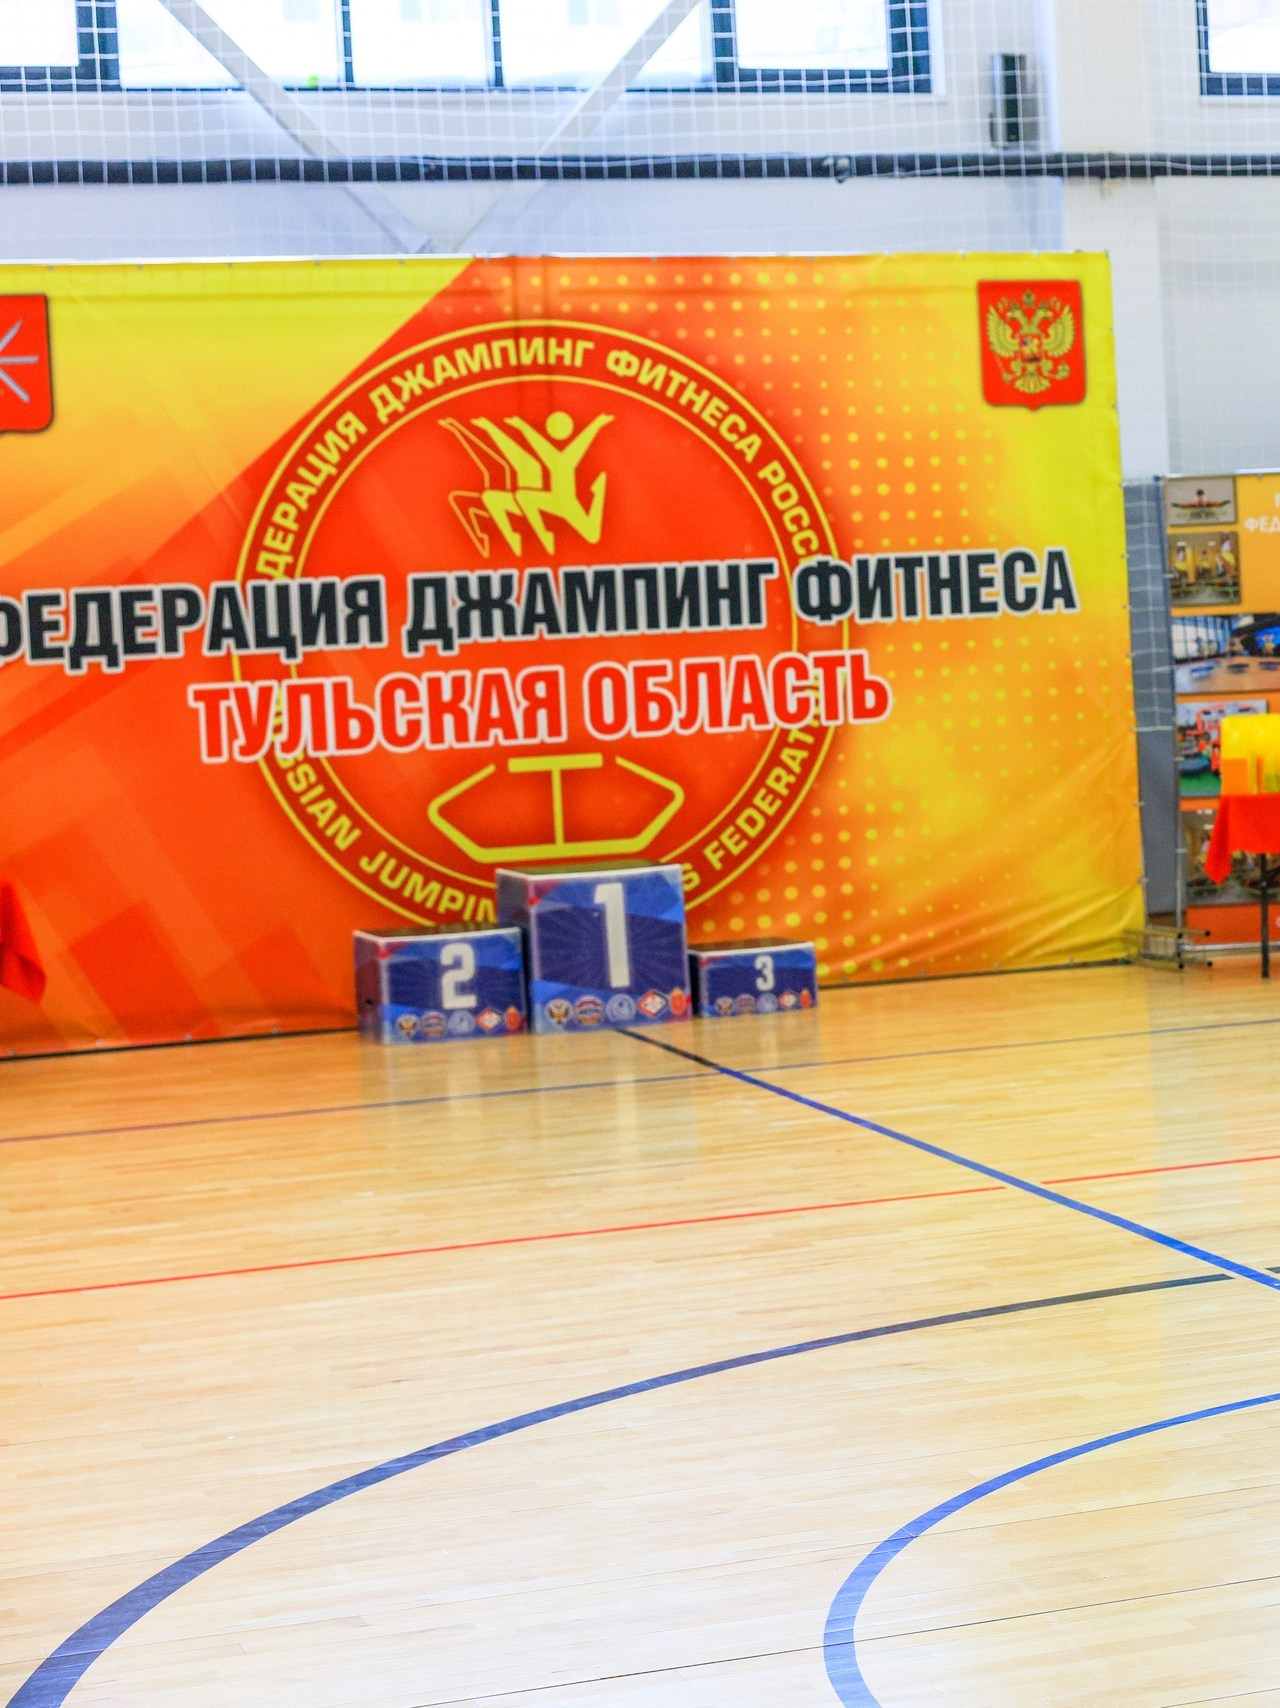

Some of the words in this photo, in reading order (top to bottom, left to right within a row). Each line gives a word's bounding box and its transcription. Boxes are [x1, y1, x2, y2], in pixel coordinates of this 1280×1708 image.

[256, 411, 367, 580] ДЕРАЦИЯ
[369, 337, 595, 424] ДЖАМПИНГ
[606, 350, 763, 464] ФИТНЕСА
[757, 459, 824, 564] РОСС
[404, 558, 779, 657] ДЖАМПИНГ
[794, 546, 1081, 626] ФИТНЕСА
[187, 664, 568, 763] ТУЛЬСКАЯ
[582, 648, 890, 742] ОБЛАСТЬ
[703, 702, 819, 871] FEDERAT
[359, 851, 497, 924] JUMPIN
[593, 881, 630, 988] 1
[439, 943, 478, 1010] 2
[754, 954, 776, 992] 3
